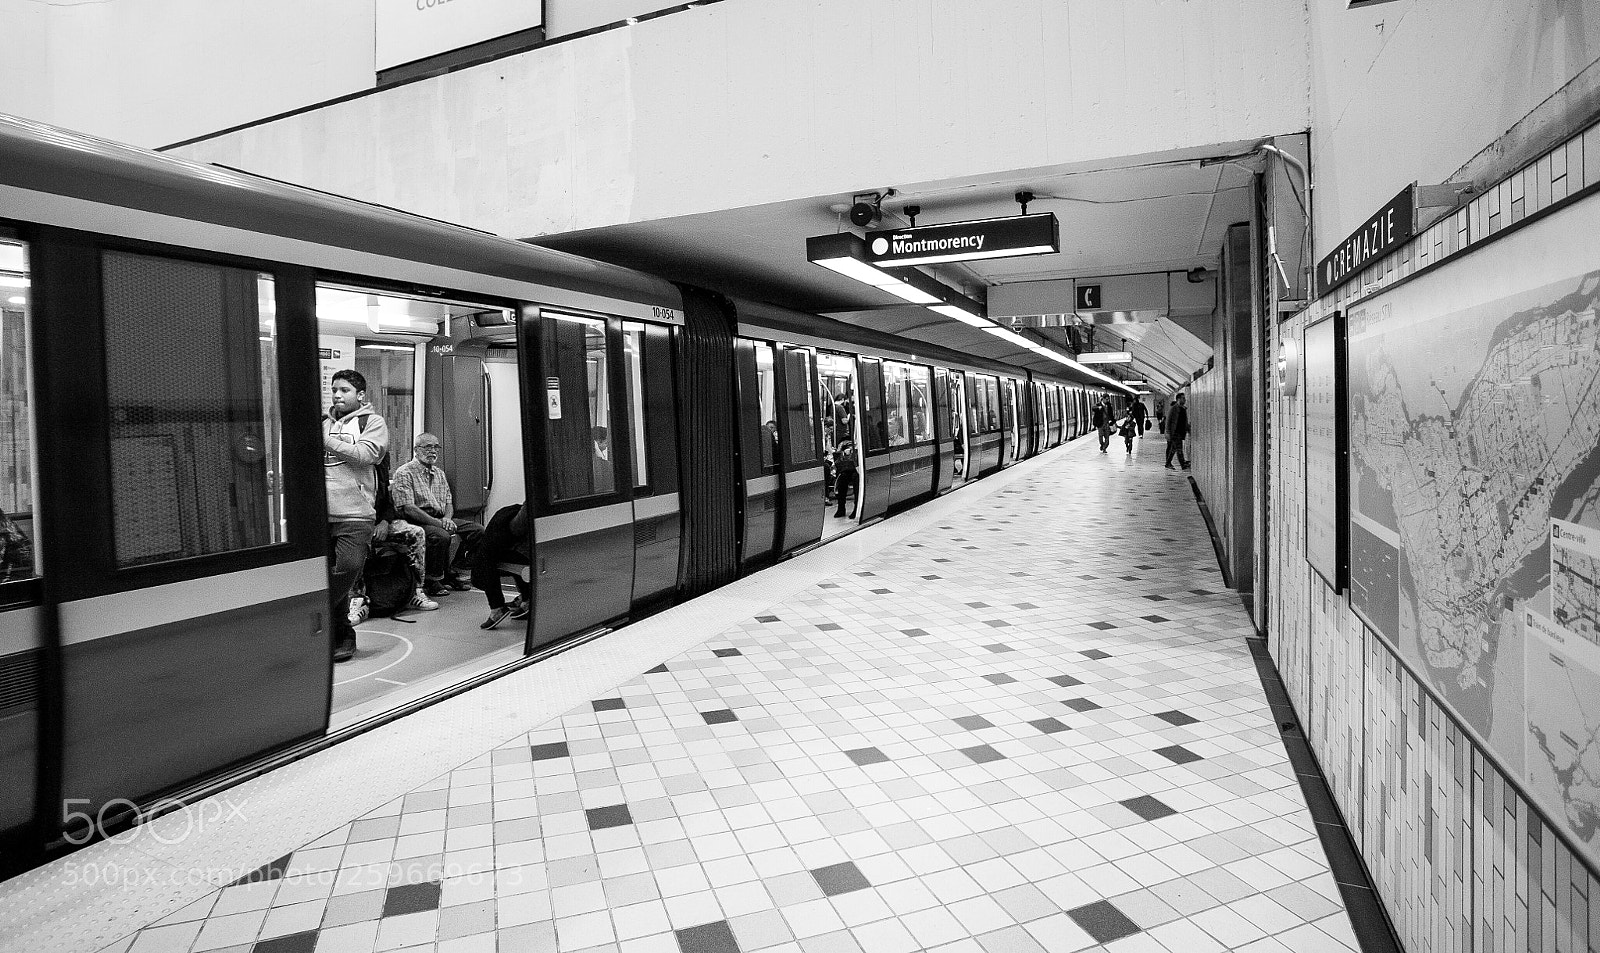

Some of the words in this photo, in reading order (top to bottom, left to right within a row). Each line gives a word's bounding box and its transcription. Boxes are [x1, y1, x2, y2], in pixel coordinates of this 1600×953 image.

[892, 234, 985, 254] Montmorency
[1333, 207, 1394, 281] CRÉMAZIE
[1560, 528, 1587, 545] Centre-ville
